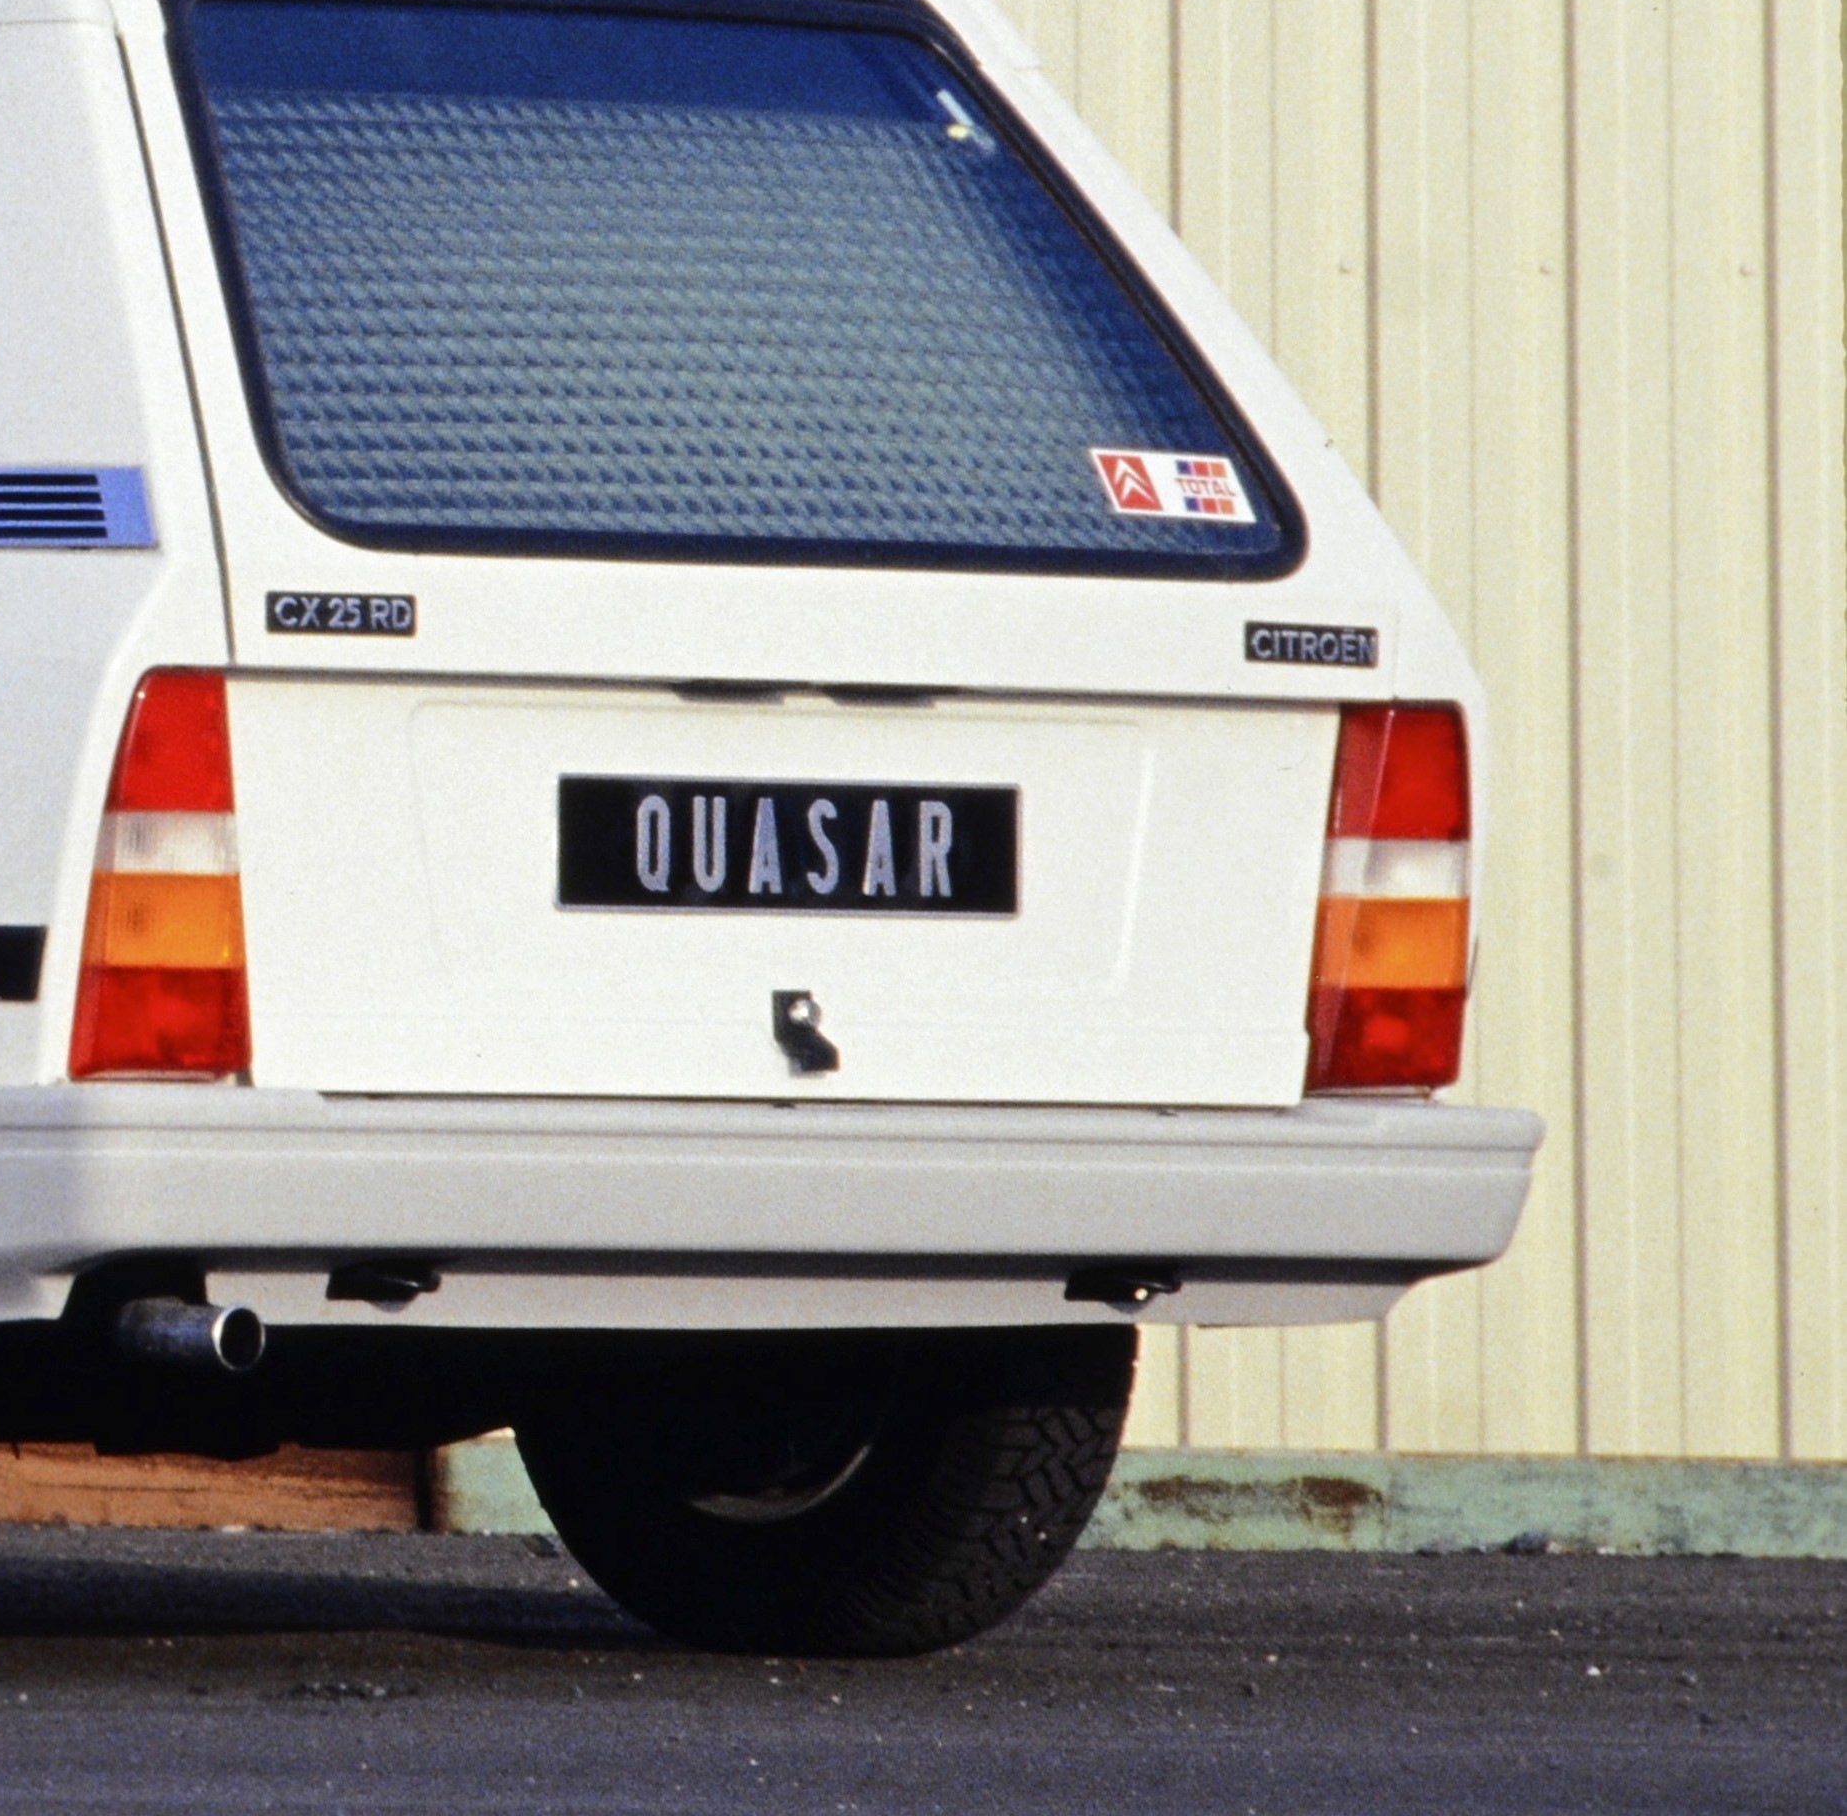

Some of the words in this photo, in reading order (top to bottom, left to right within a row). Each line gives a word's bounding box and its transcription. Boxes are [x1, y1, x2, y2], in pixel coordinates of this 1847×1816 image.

[1175, 478, 1236, 496] TOTAL
[274, 596, 320, 628] CX
[328, 597, 362, 628] 25
[369, 598, 412, 629] RD
[636, 795, 952, 897] QUASAR
